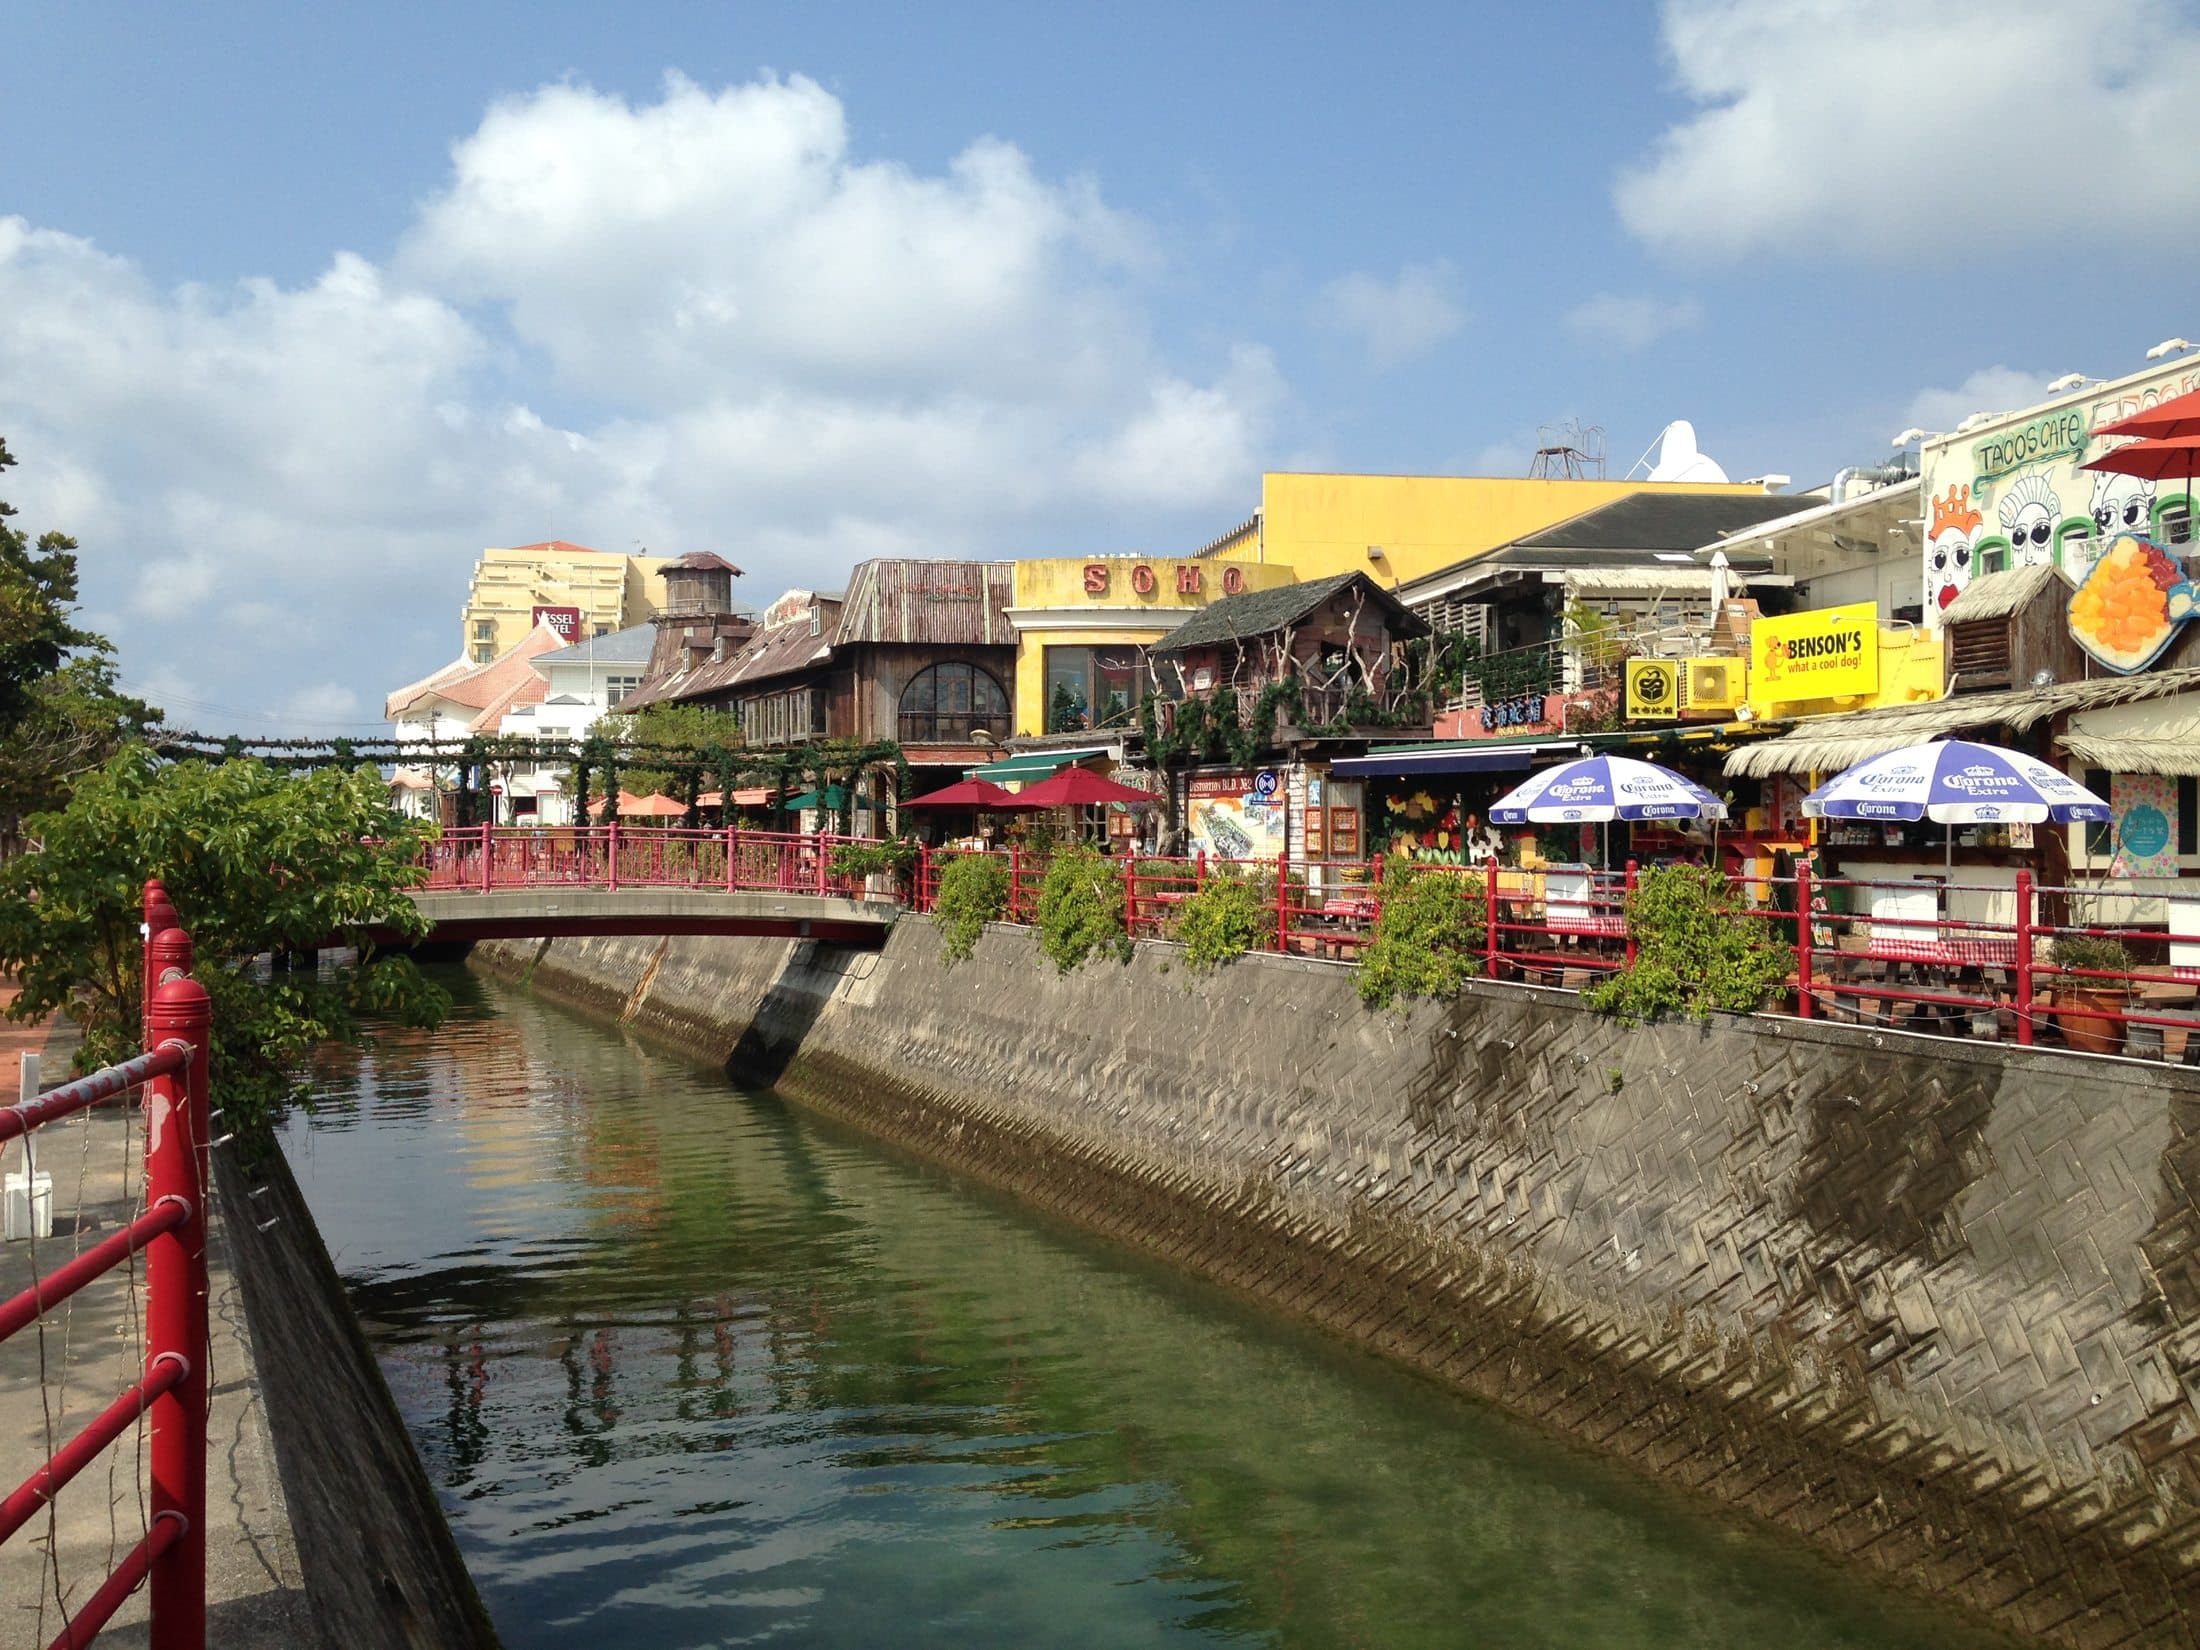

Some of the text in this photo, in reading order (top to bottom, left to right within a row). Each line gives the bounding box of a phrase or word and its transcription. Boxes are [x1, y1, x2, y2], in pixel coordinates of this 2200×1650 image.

[1980, 426, 2038, 471] TACOS
[1083, 564, 1244, 595] SOHO
[536, 613, 576, 625] VSSEL
[1787, 630, 1862, 659] BENSON'S
[1788, 653, 1862, 673] what a cool dog!
[1859, 774, 1926, 786] Corona
[1942, 774, 2019, 790] Corona
[1549, 783, 1606, 798] Corona
[1620, 783, 1674, 794] Corona
[1871, 785, 1905, 793] Extra
[1968, 787, 2009, 796] Extra
[1642, 804, 1675, 817] Corona
[1856, 802, 1897, 817] Corona
